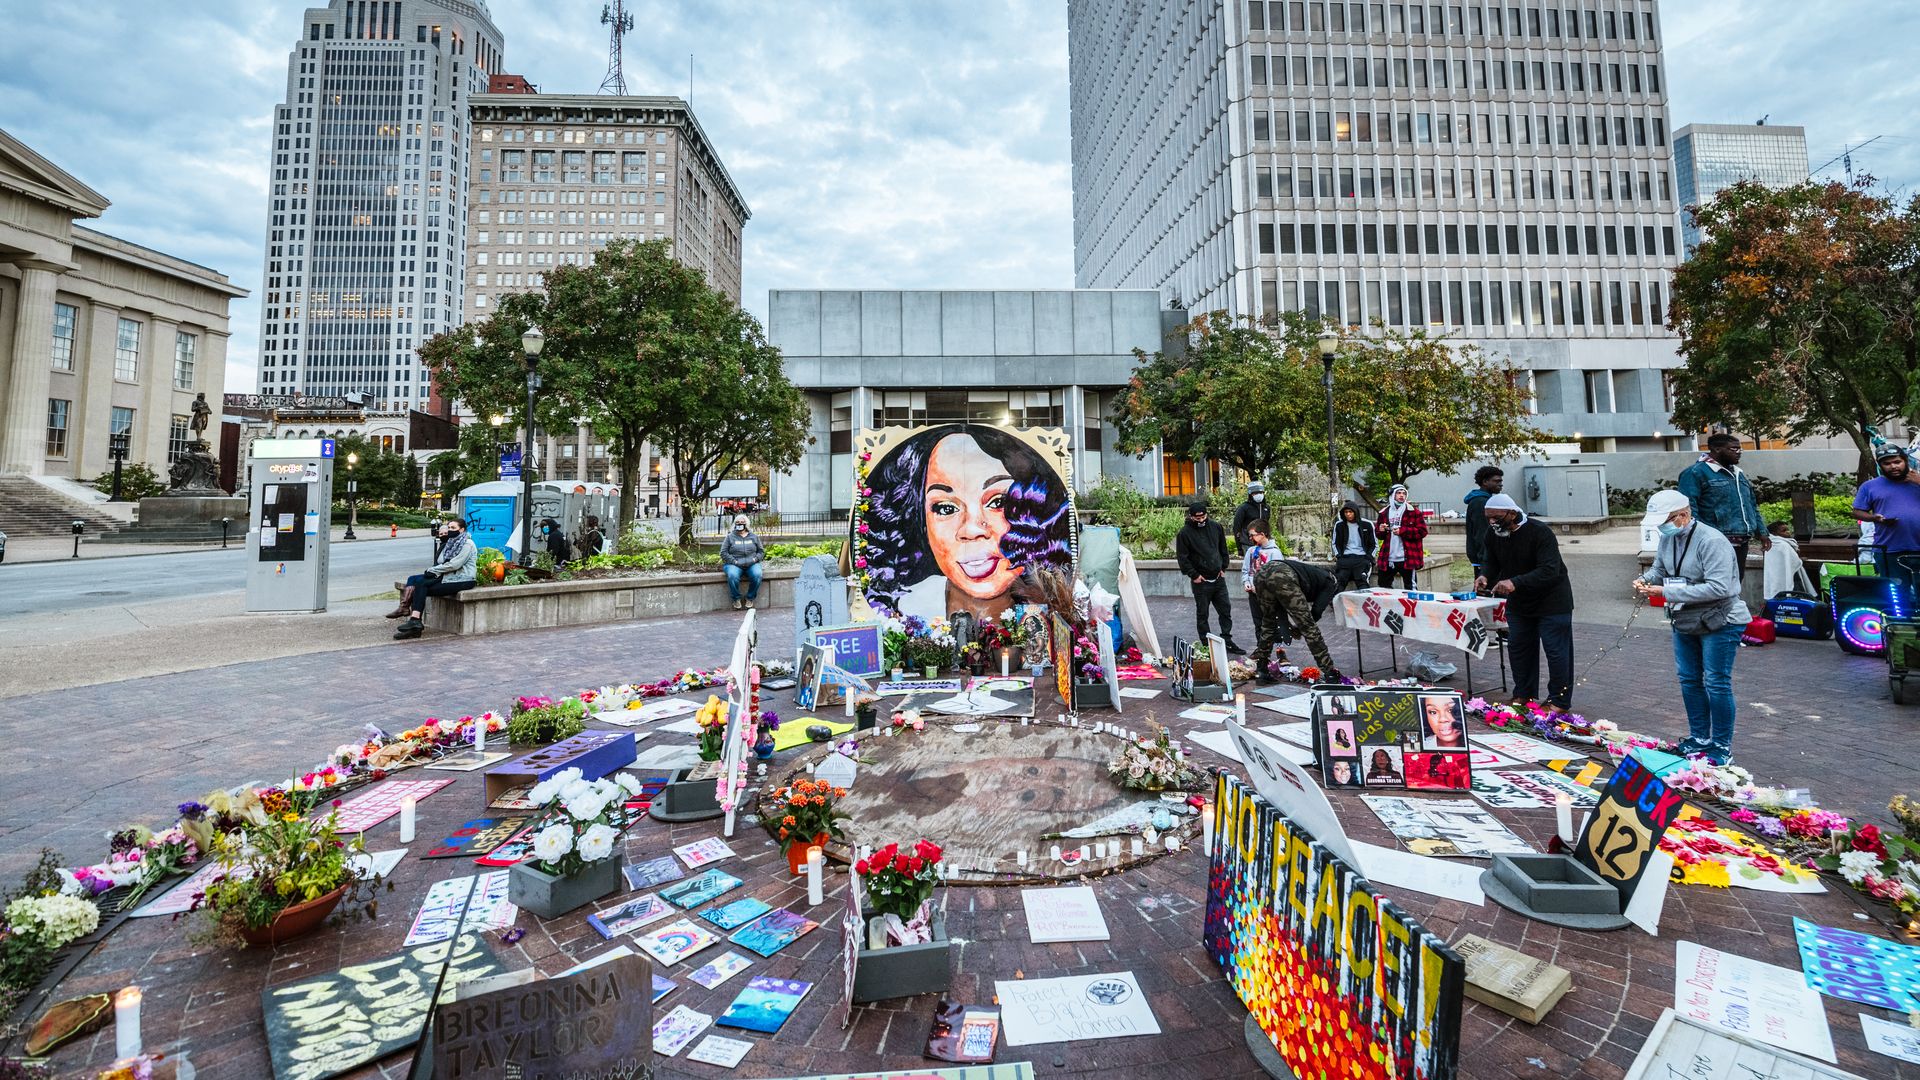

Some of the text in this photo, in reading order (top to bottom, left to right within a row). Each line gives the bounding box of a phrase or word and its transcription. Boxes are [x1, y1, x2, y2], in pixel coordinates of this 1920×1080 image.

[1357, 696, 1385, 722] She
[1384, 693, 1414, 721] asleep
[1356, 719, 1384, 743] was
[1609, 756, 1682, 829] FUCK
[1594, 814, 1638, 879] 12
[1216, 772, 1443, 1050] NO PEACE!
[438, 971, 623, 1046] BREONNA
[1009, 983, 1070, 1005] Protect
[1027, 996, 1100, 1026] Black
[1056, 1014, 1138, 1039] Women
[446, 1014, 602, 1079] TAYLOR
